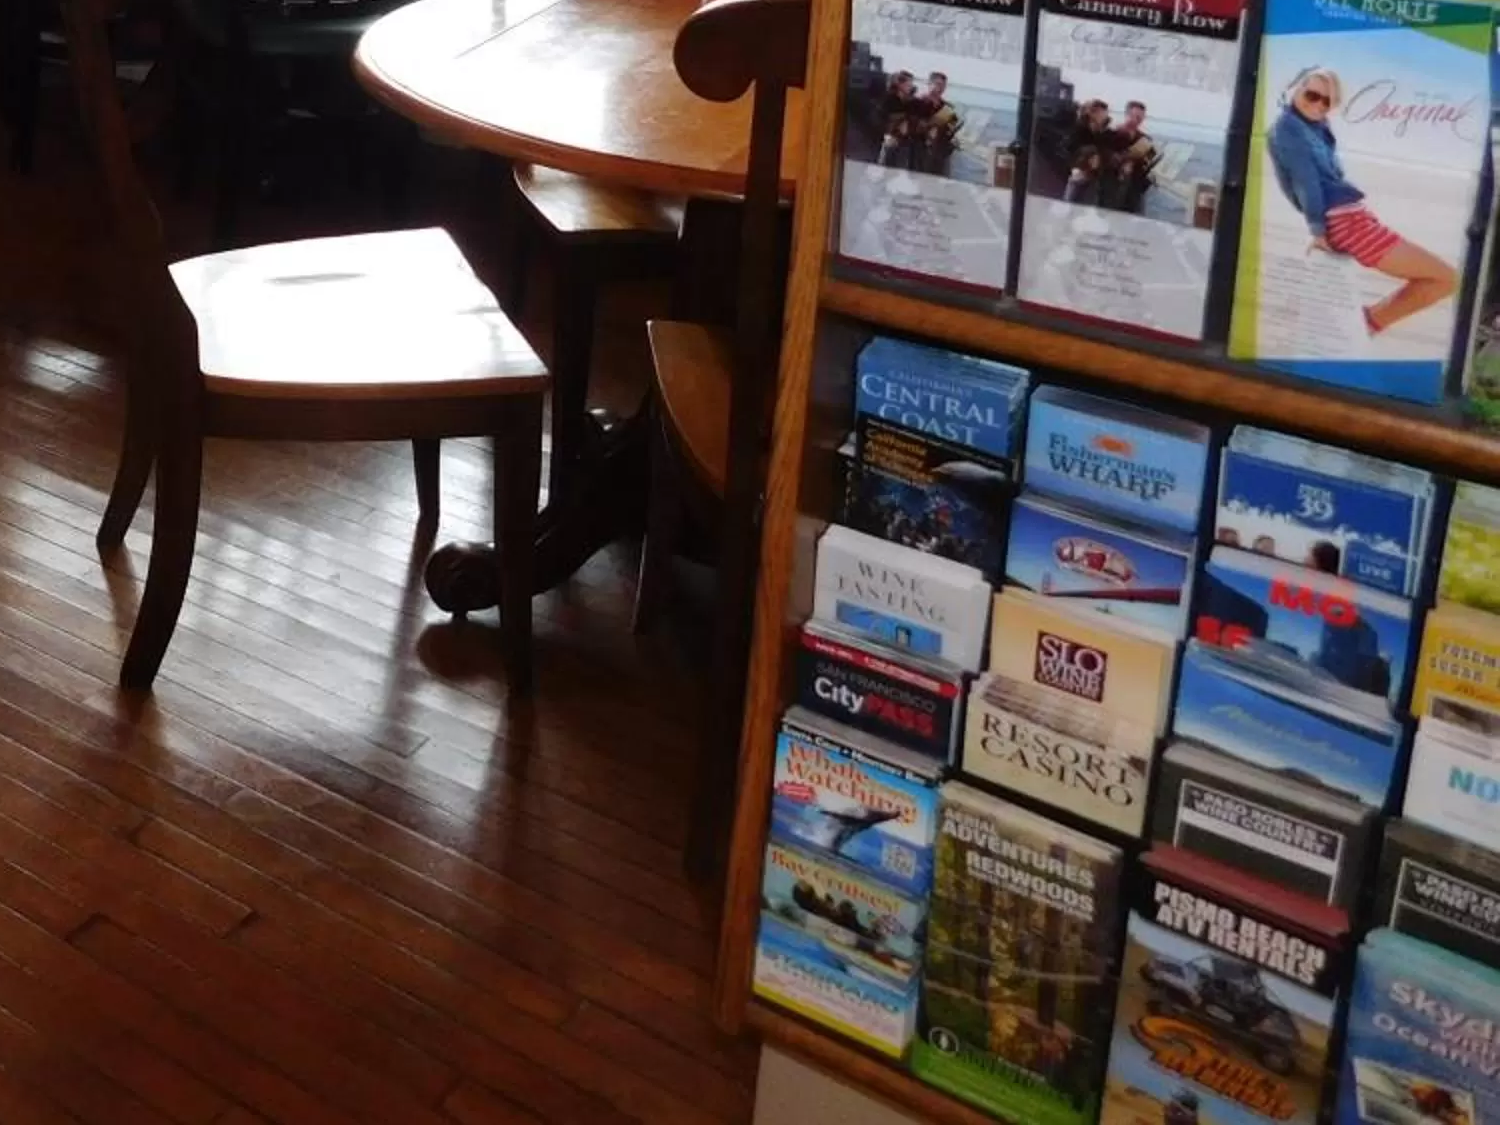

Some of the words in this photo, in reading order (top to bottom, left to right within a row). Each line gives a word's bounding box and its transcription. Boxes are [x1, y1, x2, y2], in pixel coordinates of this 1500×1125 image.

[861, 373, 1000, 428] CENTRAL
[879, 402, 981, 446] COAST
[1048, 452, 1177, 500] WHARF
[1297, 493, 1334, 521] 39
[837, 575, 947, 622] TASTING
[858, 559, 925, 593] WINE
[1039, 651, 1100, 690] WINE
[1041, 635, 1105, 675] SLO
[789, 740, 870, 784] Whale
[980, 737, 1134, 807] CASINO
[981, 713, 1142, 785] RESORT
[942, 818, 1095, 890] ADVENTURES
[966, 849, 1095, 913] REDWOODS
[1153, 880, 1236, 931] PISMO
[1239, 915, 1327, 971] BEACH
[1155, 902, 1206, 938] ATV
[1207, 923, 1316, 985] RENTALS
[1372, 1012, 1469, 1068] Ocean
